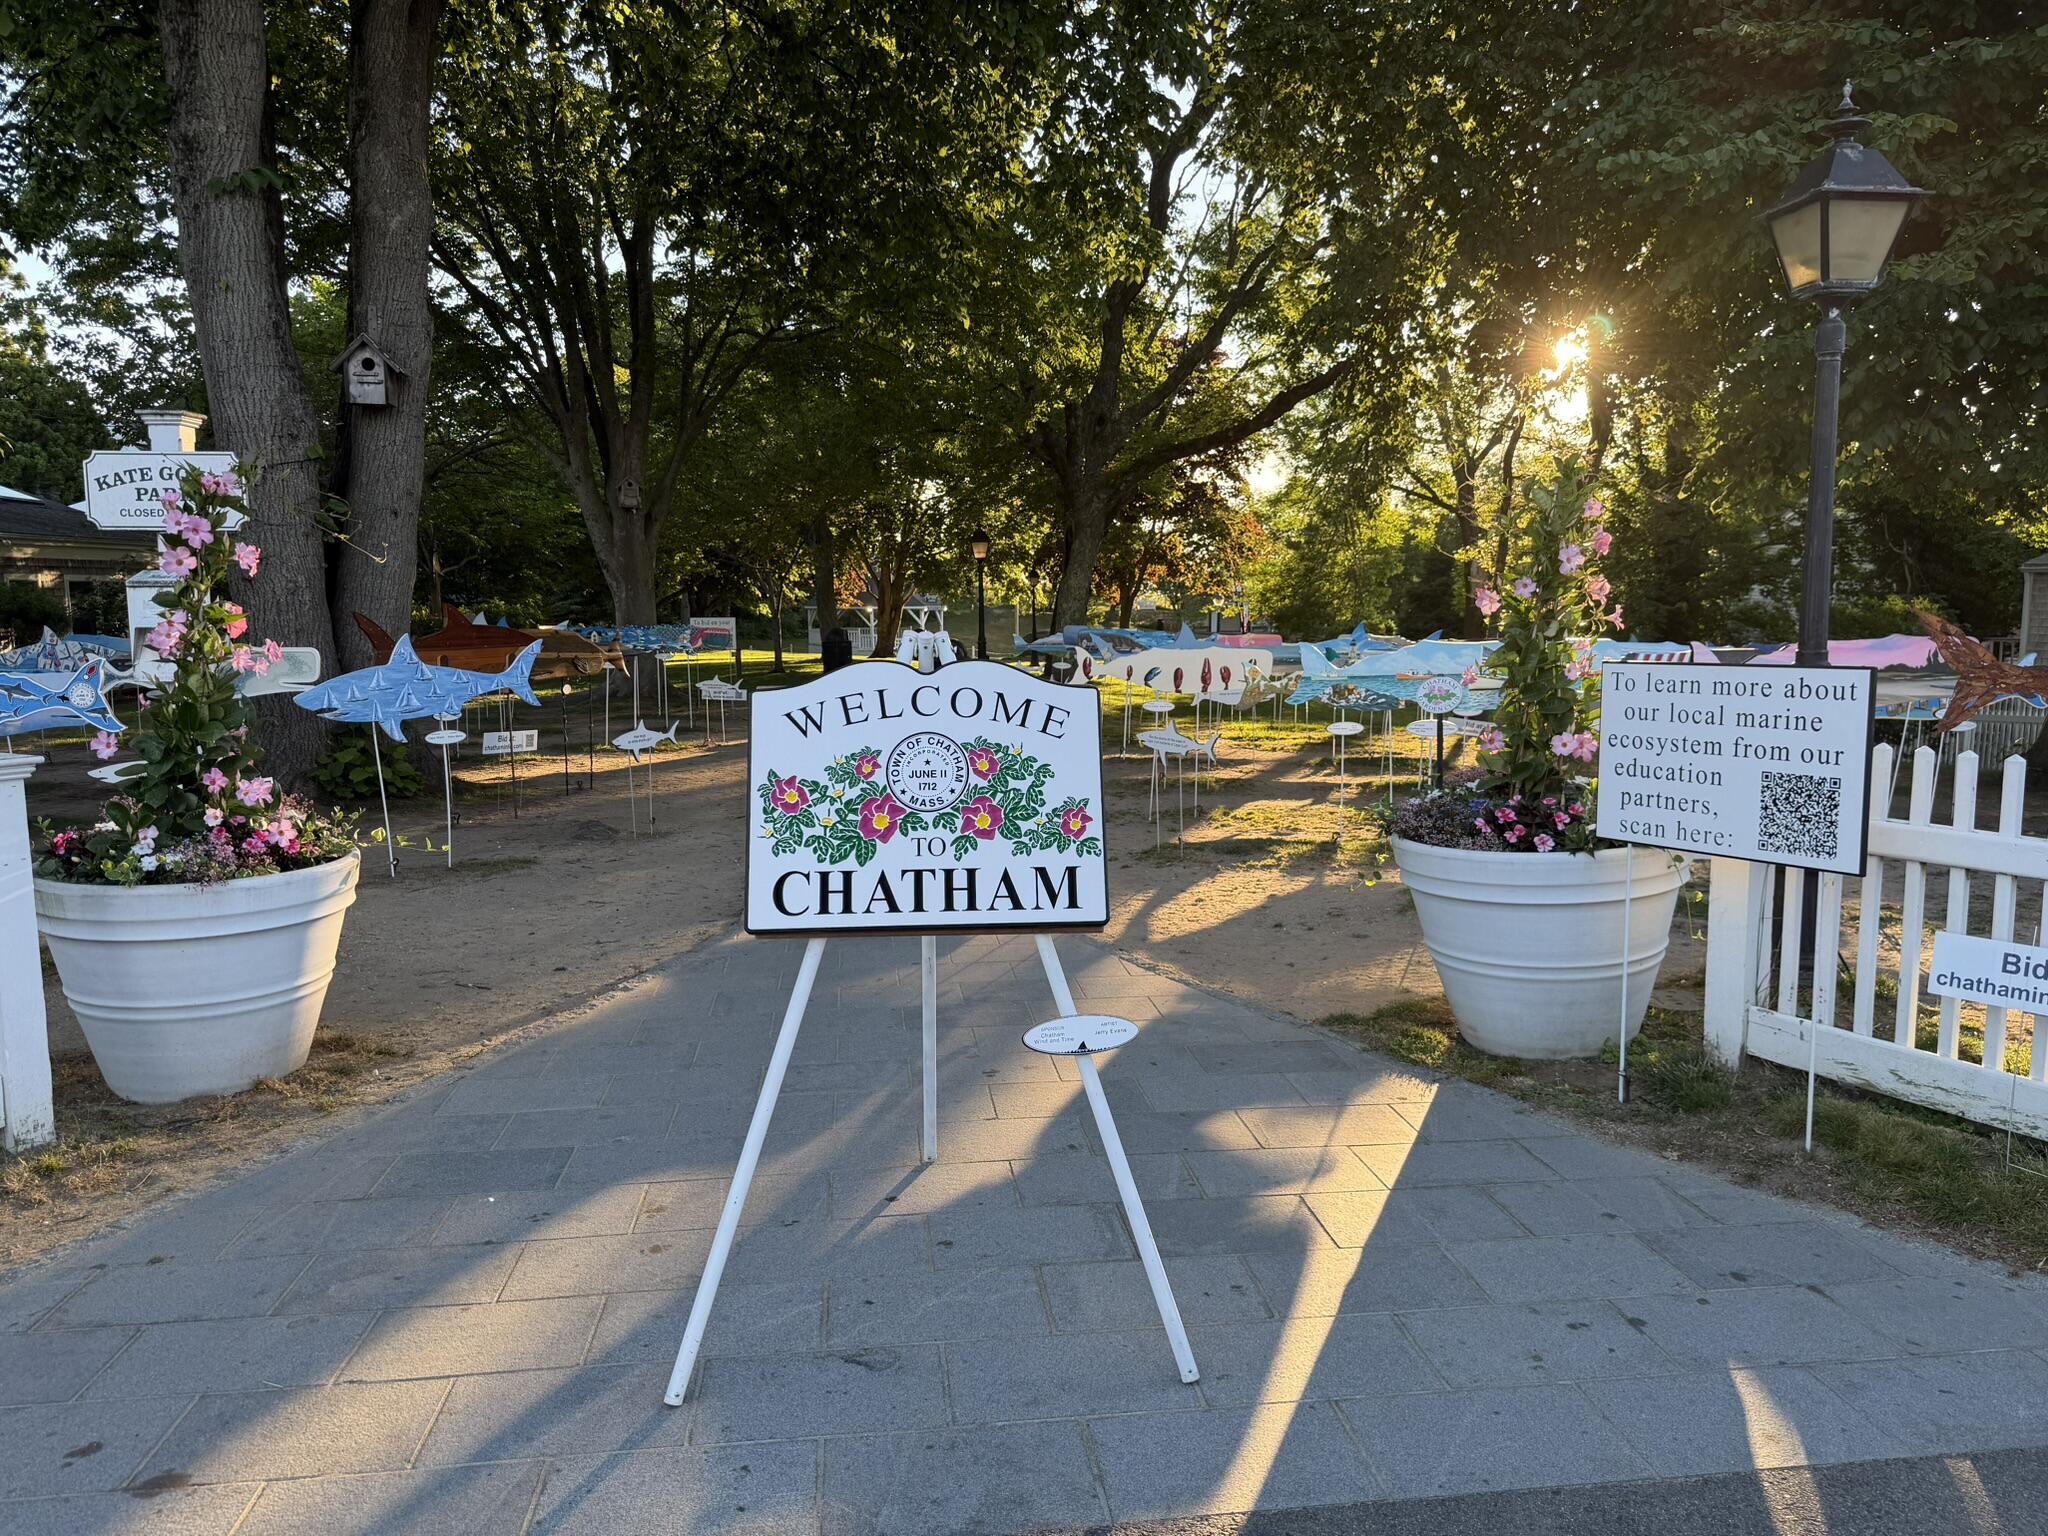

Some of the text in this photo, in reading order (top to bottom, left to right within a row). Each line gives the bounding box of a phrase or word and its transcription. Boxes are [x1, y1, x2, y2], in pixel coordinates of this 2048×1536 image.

[94, 467, 153, 492] KATE
[120, 508, 165, 517] CLOSED
[1611, 671, 1858, 701] To learn more about
[783, 685, 1071, 739] WELCOME
[1624, 702, 1823, 732] our local marine
[890, 736, 964, 786] TOWN OF CHATHAM
[906, 749, 950, 768] INCORPORATED
[1608, 733, 1845, 766] ecosystem from our
[908, 769, 937, 779] JUNE
[1614, 758, 1723, 786] education
[918, 782, 937, 791] 1712
[909, 795, 949, 807] MASS.
[1620, 791, 1719, 819] partners,
[911, 836, 946, 857] TO
[1619, 818, 1733, 847] scan here:
[772, 865, 1083, 917] CHATHAM
[2001, 952, 2048, 981] Bid
